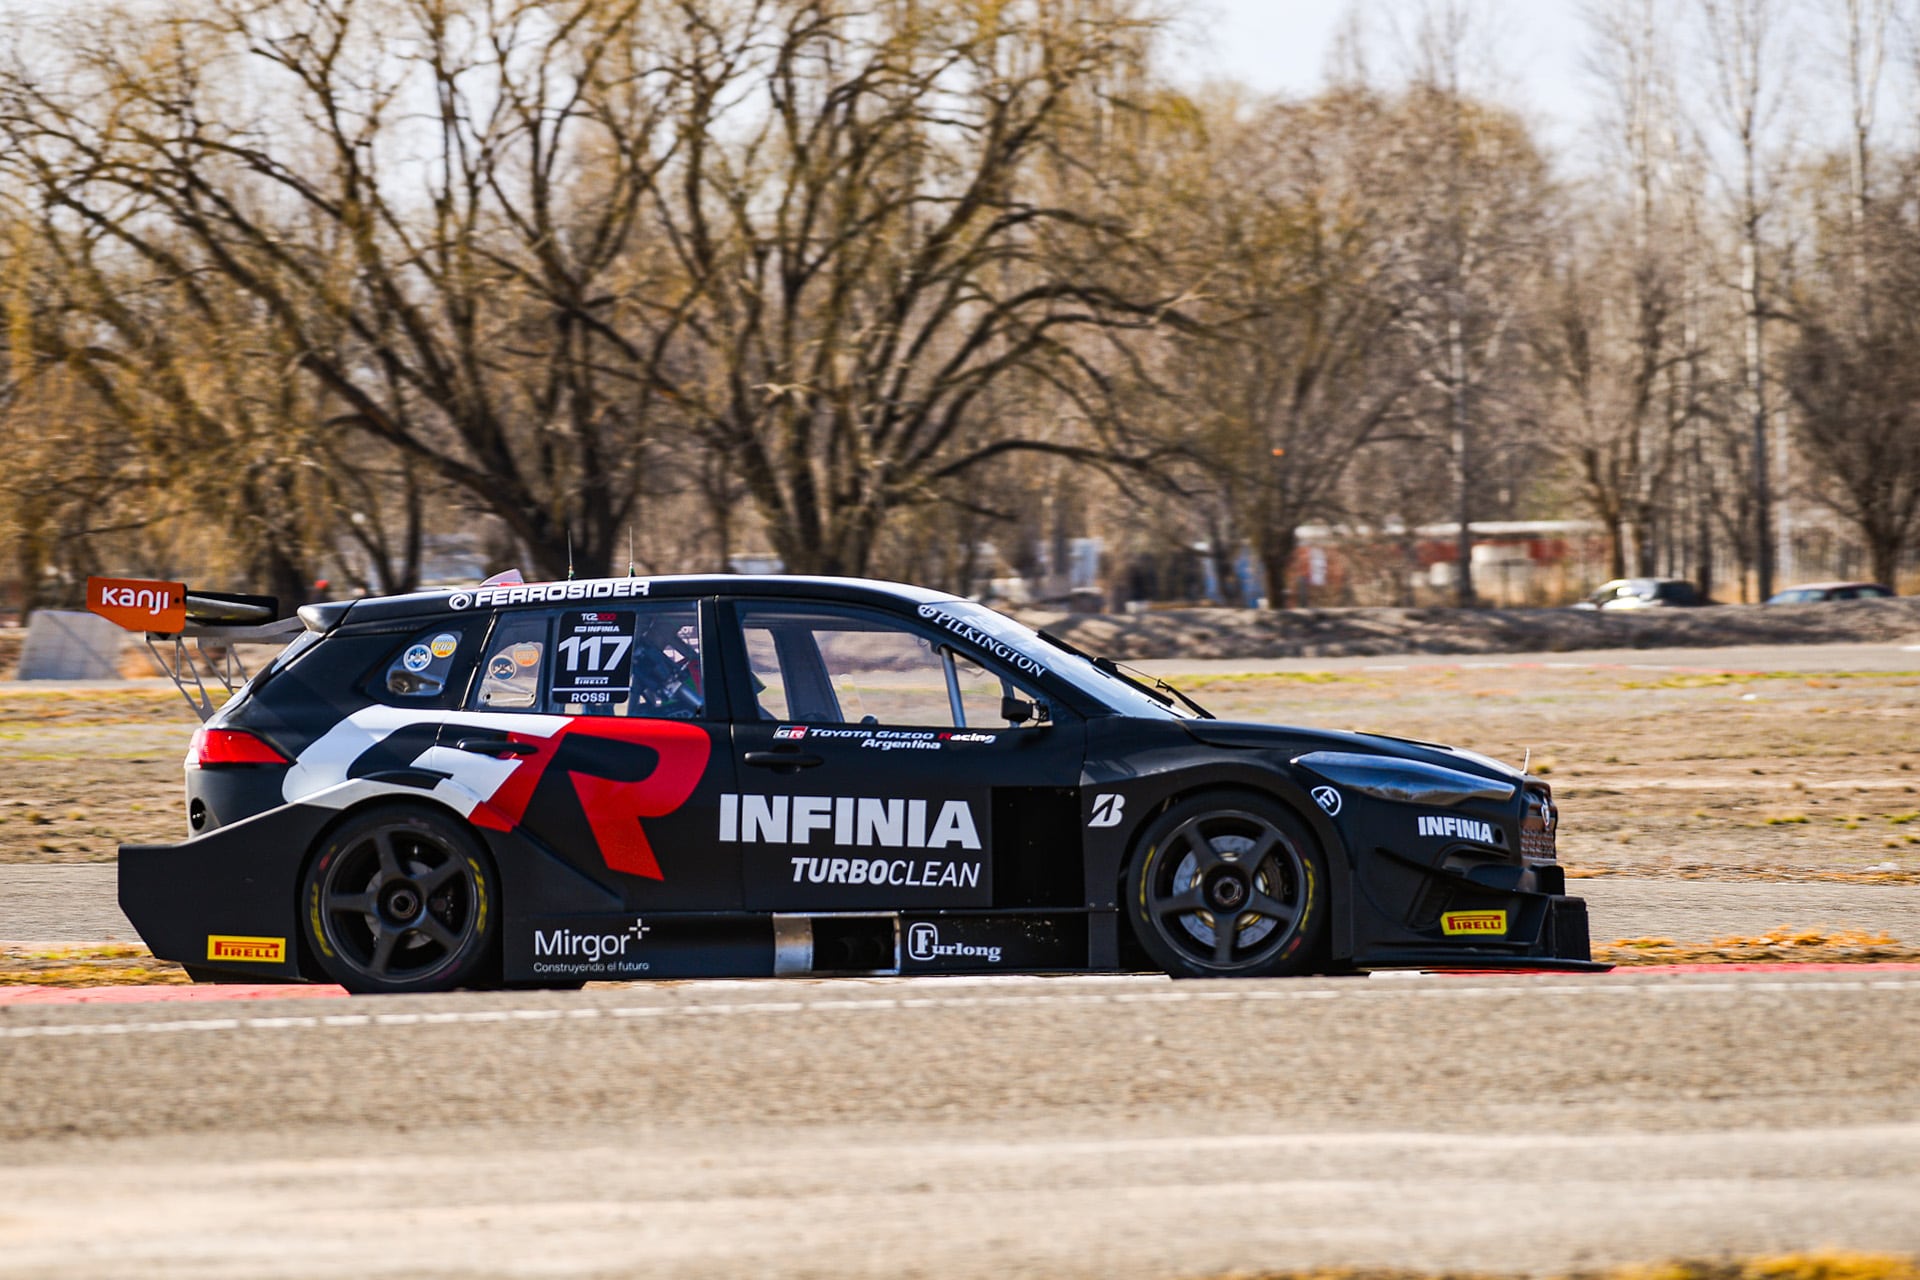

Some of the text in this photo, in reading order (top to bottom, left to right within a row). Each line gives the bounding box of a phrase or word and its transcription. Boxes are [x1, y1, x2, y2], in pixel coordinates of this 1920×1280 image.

[474, 580, 651, 608] FERROSIDER
[558, 636, 633, 671] 117
[933, 611, 1046, 678] PILKINGTON
[571, 693, 610, 703] ROSSI
[861, 739, 942, 750] Argentina
[938, 732, 997, 744] Racing
[719, 793, 982, 850] INFINIA
[1418, 816, 1494, 844] INFINIA
[790, 857, 982, 888] TURBOCLEAN
[1447, 915, 1502, 930] PIRELLI
[215, 941, 280, 958] PIRELLI
[534, 928, 631, 962] Mirgor
[914, 929, 1002, 962] Furlong
[533, 961, 649, 974] Construyendo el futuro
